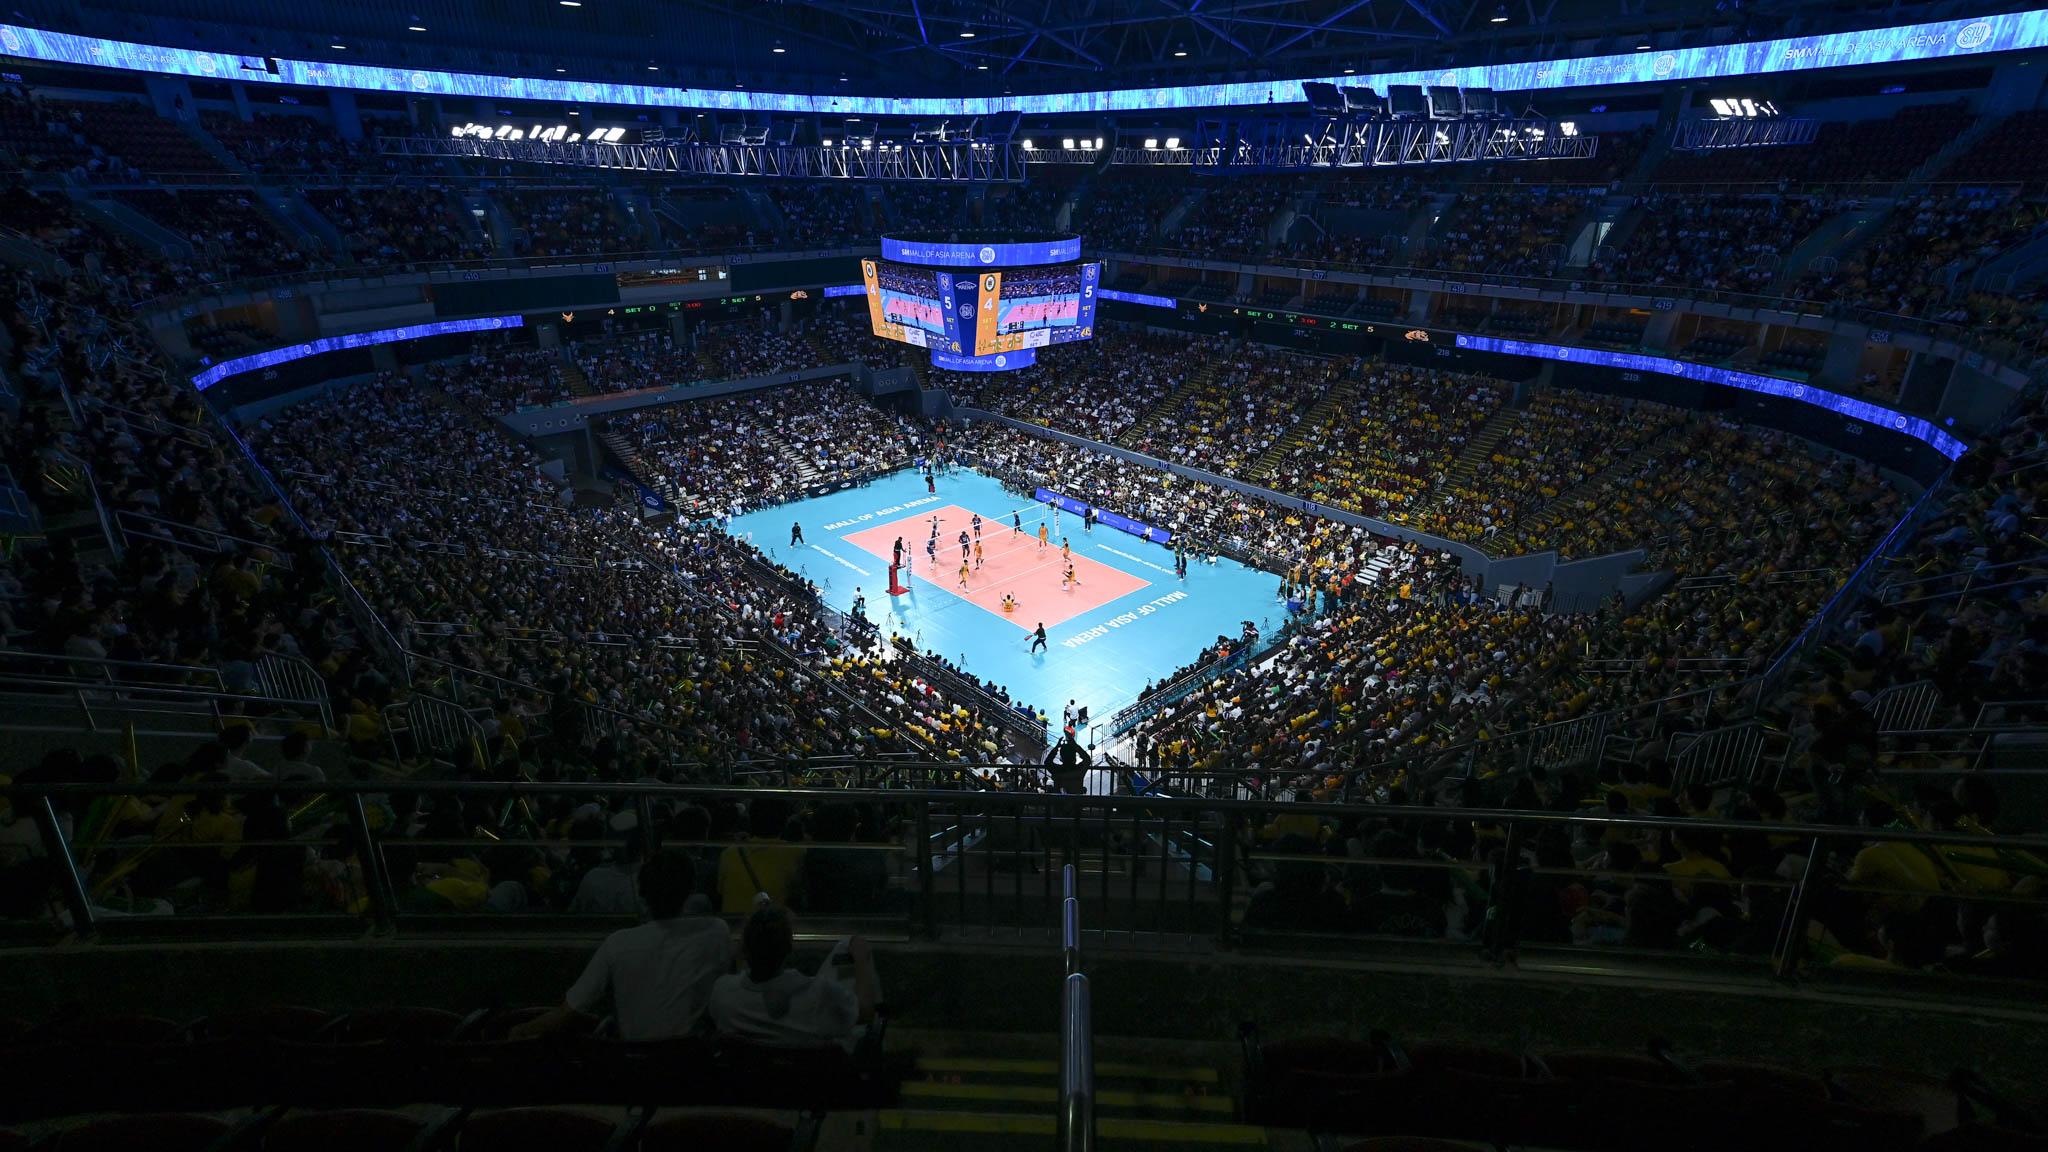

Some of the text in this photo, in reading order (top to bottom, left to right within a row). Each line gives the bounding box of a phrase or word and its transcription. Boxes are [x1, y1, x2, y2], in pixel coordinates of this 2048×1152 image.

[1897, 33, 1947, 49] ARENA
[935, 251, 950, 259] ASIA
[951, 251, 976, 259] ARENA
[870, 284, 876, 296] 4
[1084, 285, 1093, 298] 5
[944, 296, 952, 309] 5
[984, 297, 993, 311] 4
[1655, 301, 1672, 310] 419
[1330, 321, 1337, 329] 2
[1438, 348, 1450, 356] 218
[975, 358, 992, 366] ARENA
[1623, 373, 1639, 382] 219
[1847, 422, 1863, 435] 220
[1305, 501, 1315, 511] 118
[824, 496, 942, 531] MALL OF ASIA ARENA
[1060, 590, 1189, 648] MALL OF ASIA ARENA
